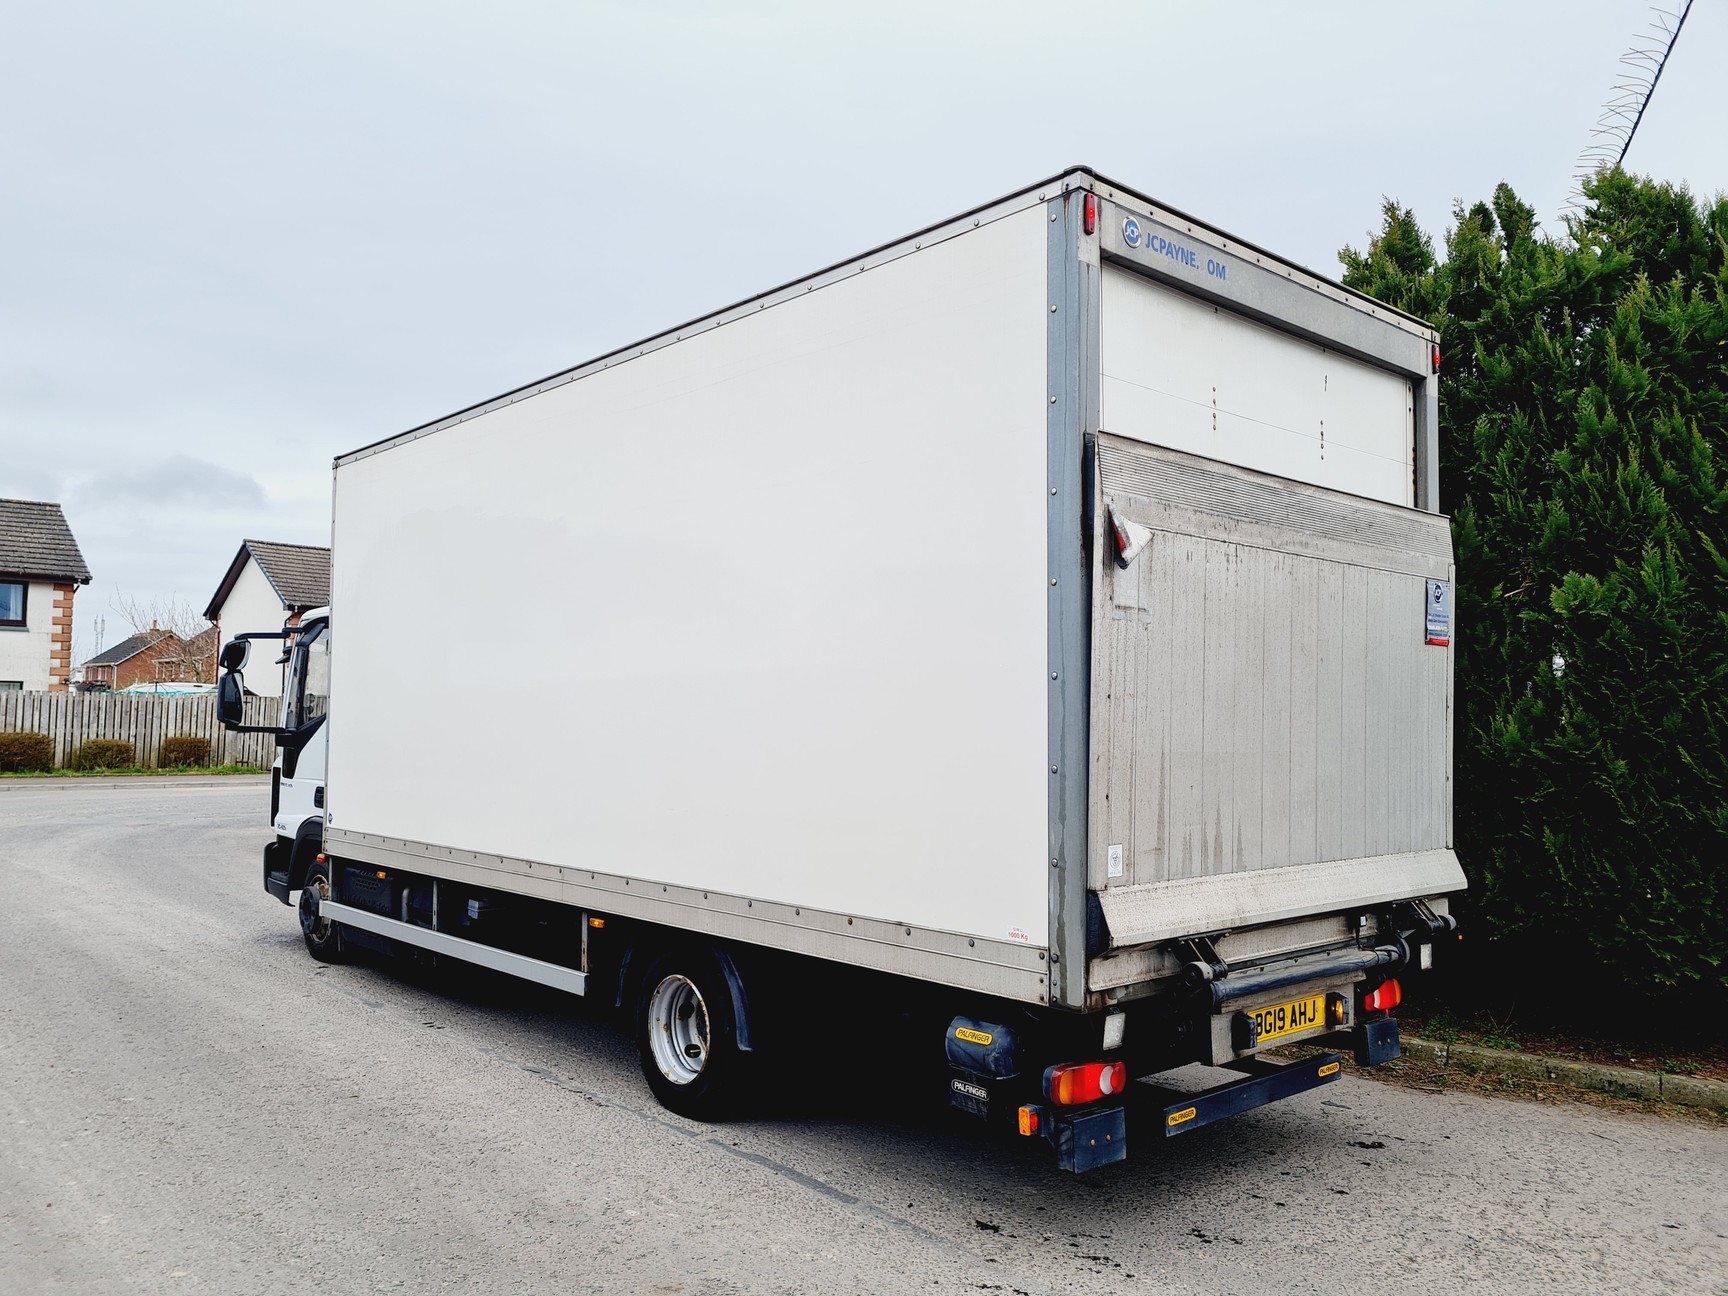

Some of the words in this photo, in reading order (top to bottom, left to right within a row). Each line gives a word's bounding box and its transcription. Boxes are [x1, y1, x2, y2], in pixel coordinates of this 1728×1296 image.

[1125, 225, 1139, 239] JCP
[1255, 1007, 1286, 1037] BG19
[1290, 1000, 1316, 1028] AHJ
[957, 1028, 990, 1044] PALFINGER
[954, 1081, 988, 1099] PALFINGER
[1169, 1109, 1195, 1124] PALFINGER
